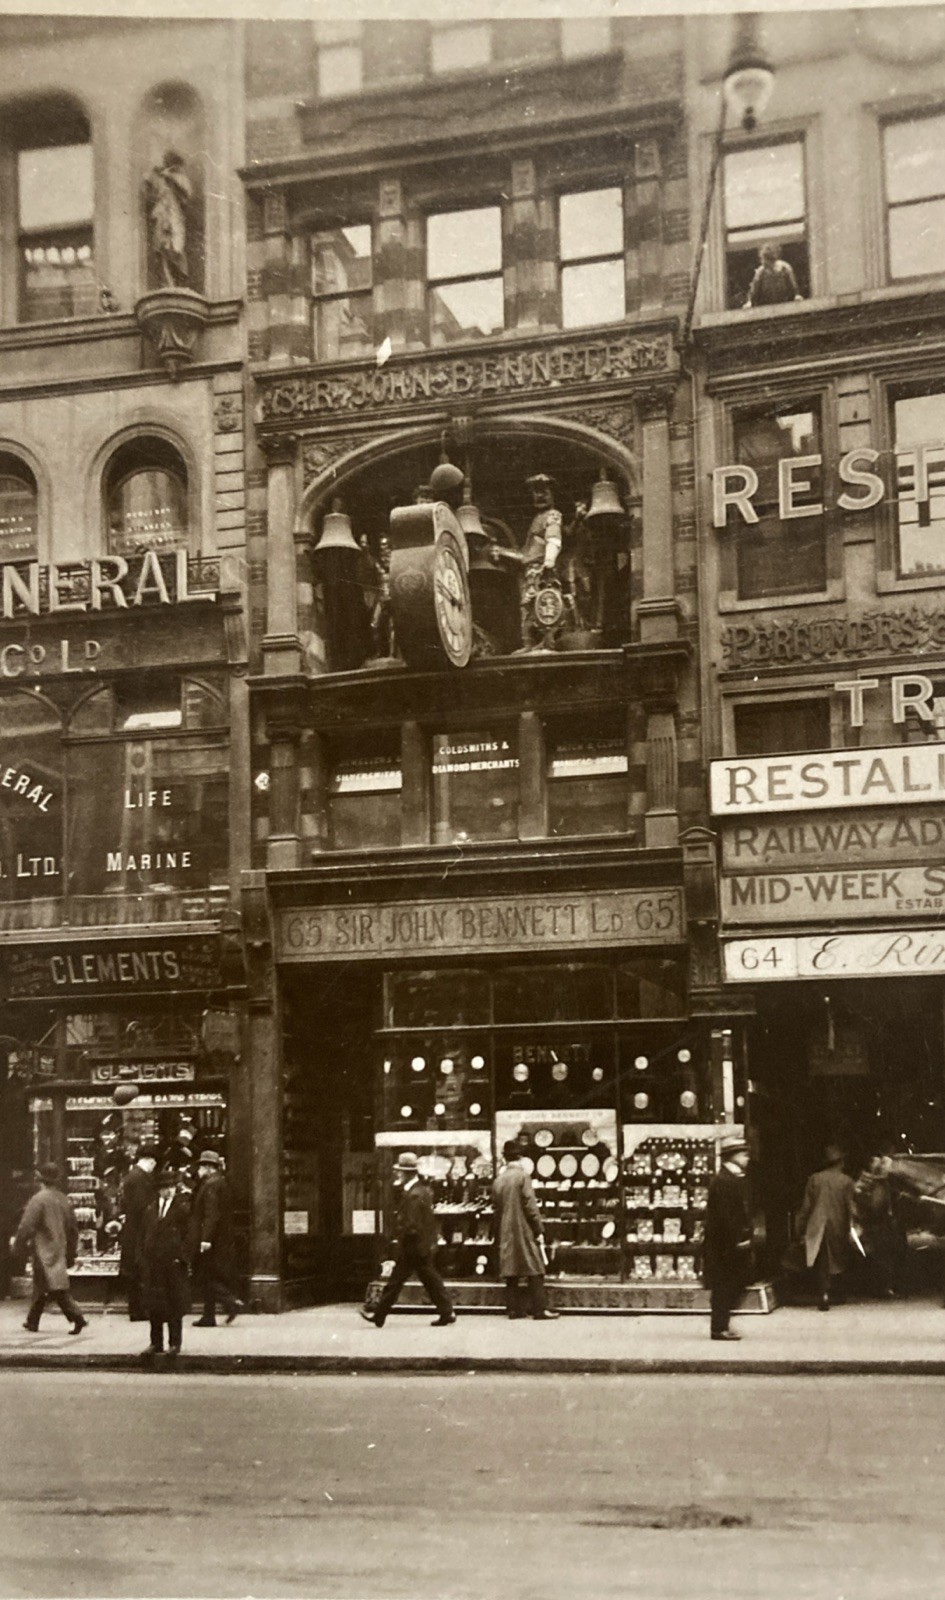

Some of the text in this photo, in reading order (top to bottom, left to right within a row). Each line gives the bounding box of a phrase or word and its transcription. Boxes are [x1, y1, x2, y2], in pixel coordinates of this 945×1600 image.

[352, 369, 431, 406] JOHN
[834, 674, 935, 727] TR
[432, 758, 520, 774] DIAMOND MERCHANTS
[0, 763, 53, 812] ERAL
[733, 815, 945, 857] RAILWAY AD
[106, 852, 192, 872] MARINE
[731, 872, 904, 907] MID-WEEK
[286, 917, 323, 948] 65
[335, 914, 375, 947] SIR
[385, 908, 449, 944] JOHN
[456, 902, 581, 941] BENNETT
[634, 898, 676, 931] 65
[51, 950, 181, 985] CLEMENTS
[741, 944, 782, 970] 64
